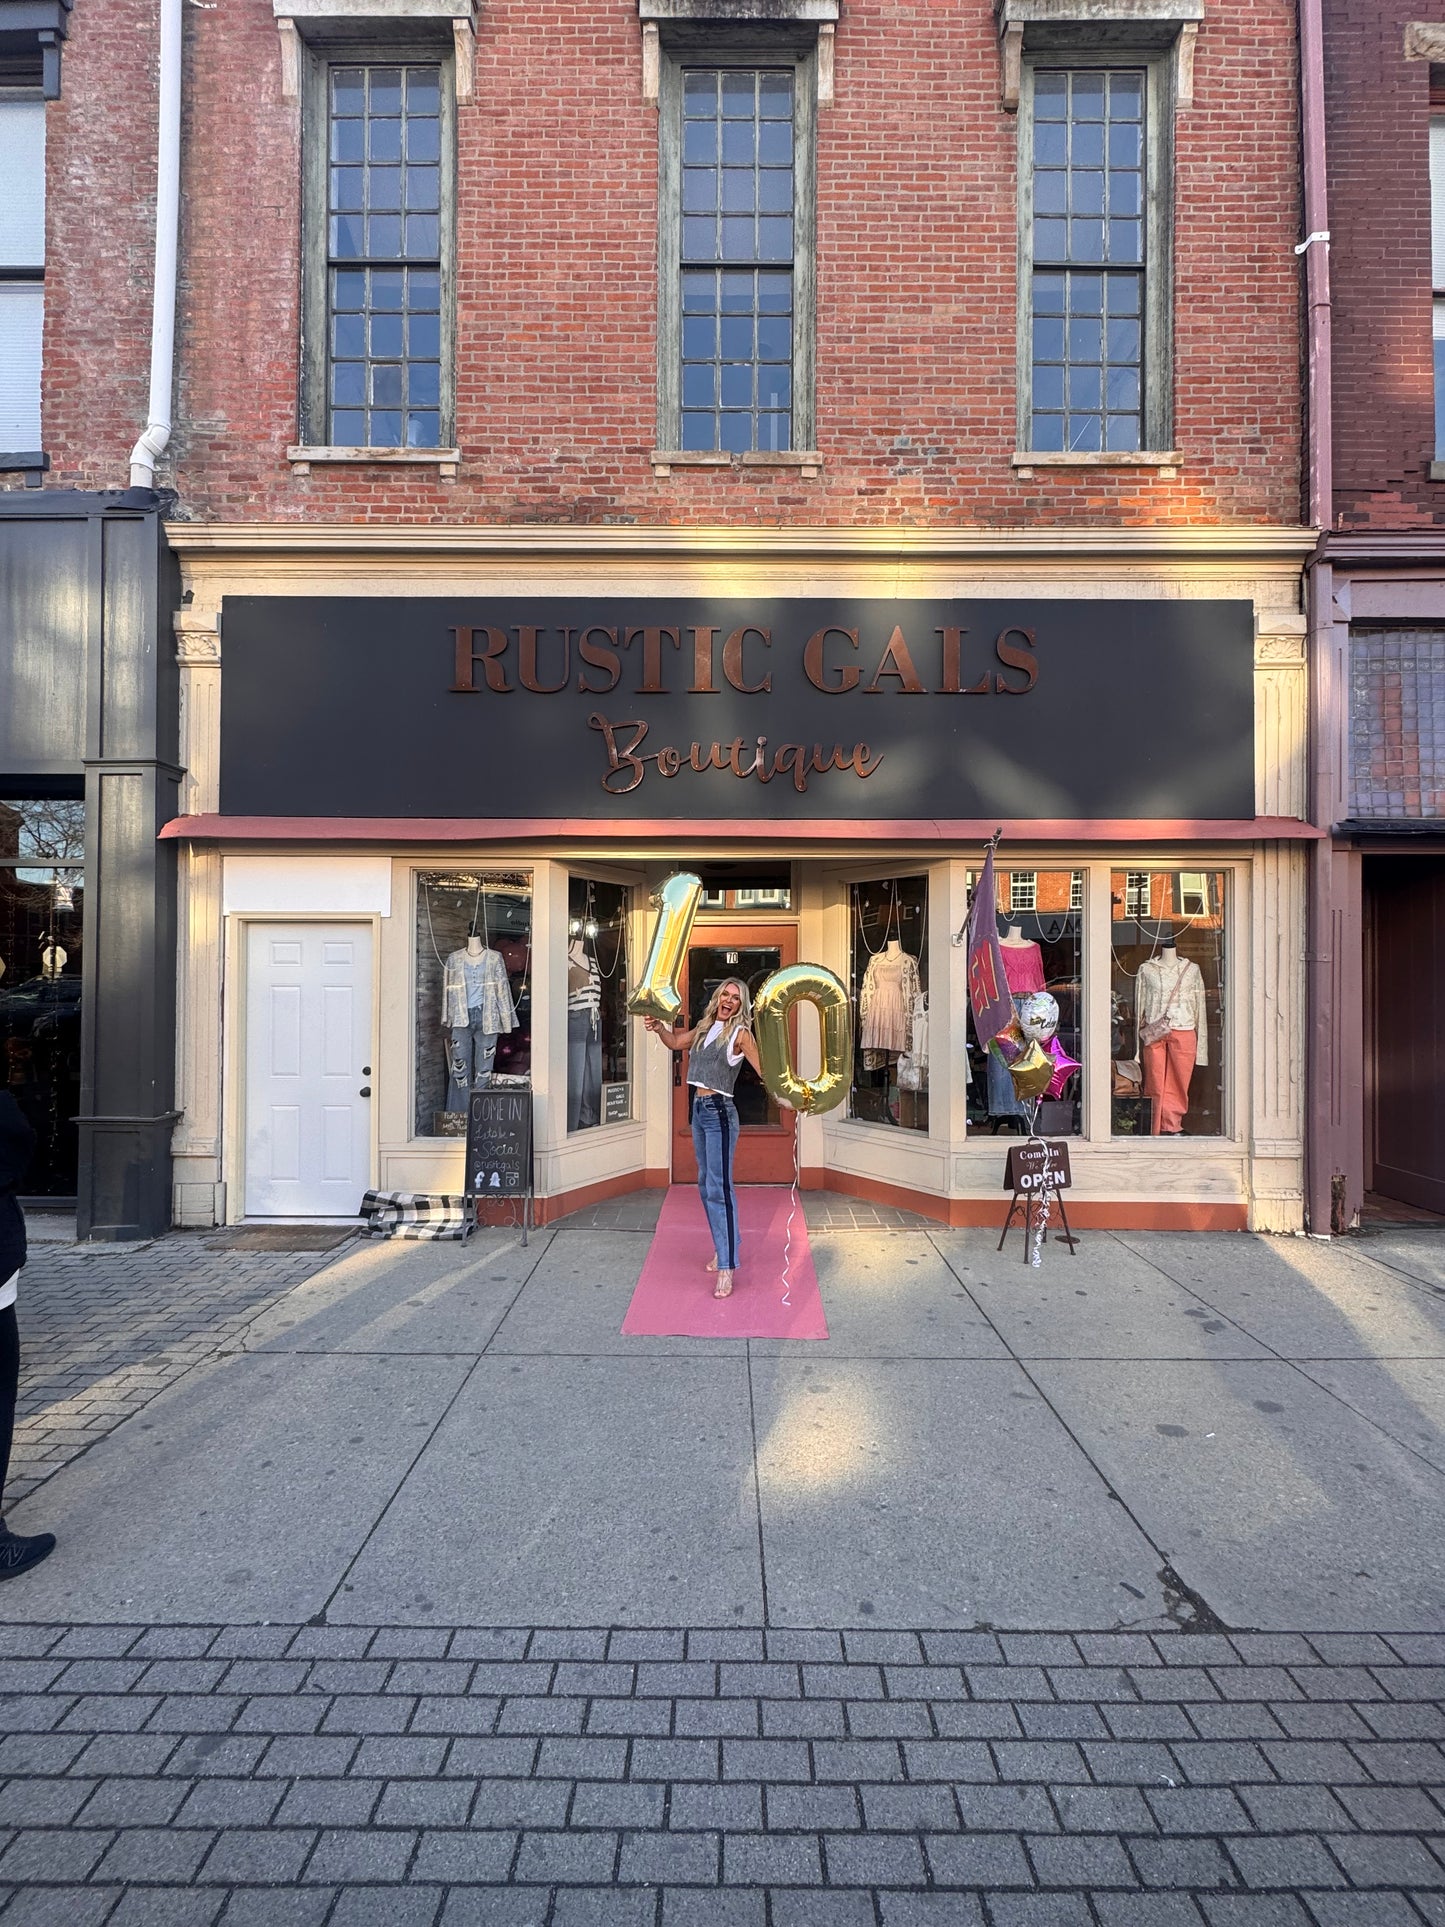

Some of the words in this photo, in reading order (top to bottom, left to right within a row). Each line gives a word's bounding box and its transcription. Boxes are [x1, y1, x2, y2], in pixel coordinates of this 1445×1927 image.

[448, 624, 773, 694] RUSTIC
[803, 624, 1040, 694] GALS
[588, 711, 884, 793] Boutique
[726, 951, 739, 964] 70
[472, 1097, 504, 1121] COME
[508, 1097, 523, 1121] IN
[477, 1141, 521, 1159] Social
[1049, 1148, 1060, 1157] In
